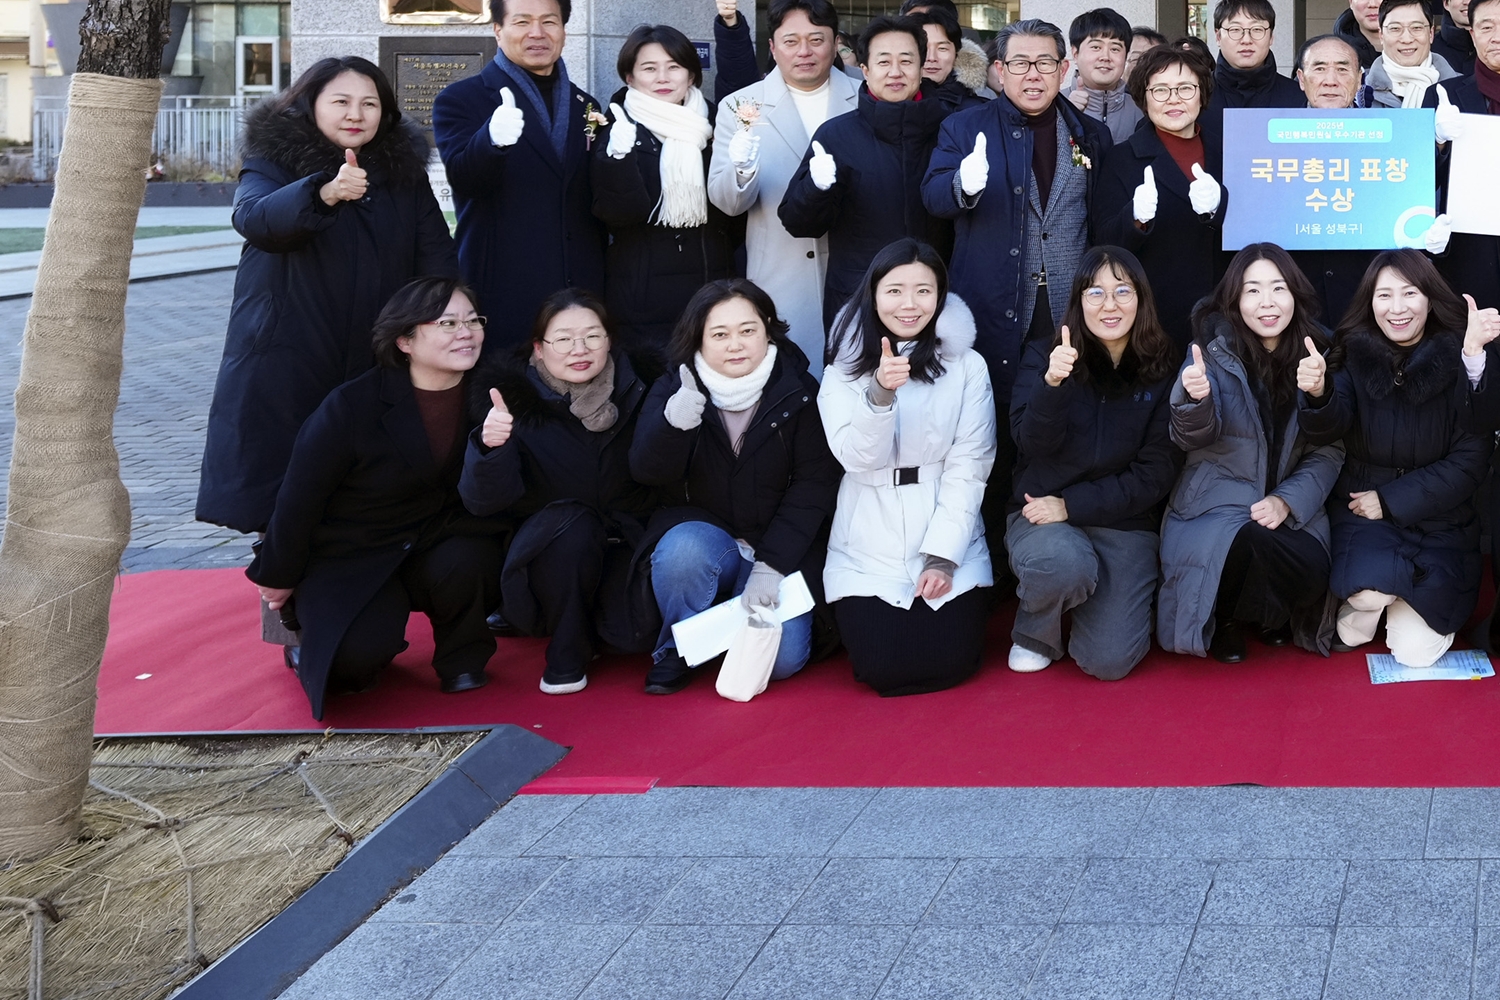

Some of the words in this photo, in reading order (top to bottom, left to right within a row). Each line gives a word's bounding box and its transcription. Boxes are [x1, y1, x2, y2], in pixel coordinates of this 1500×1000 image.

[1316, 122, 1344, 130] 2025년
[1277, 131, 1332, 139] 국민행복민원실
[1334, 131, 1366, 139] 우수기관
[1368, 131, 1384, 139] 선정
[1250, 158, 1350, 183] 국무총리
[1359, 158, 1409, 183] 표창
[1305, 188, 1355, 212] 수상
[1300, 223, 1322, 235] 서울
[1325, 223, 1359, 235] 성북구
